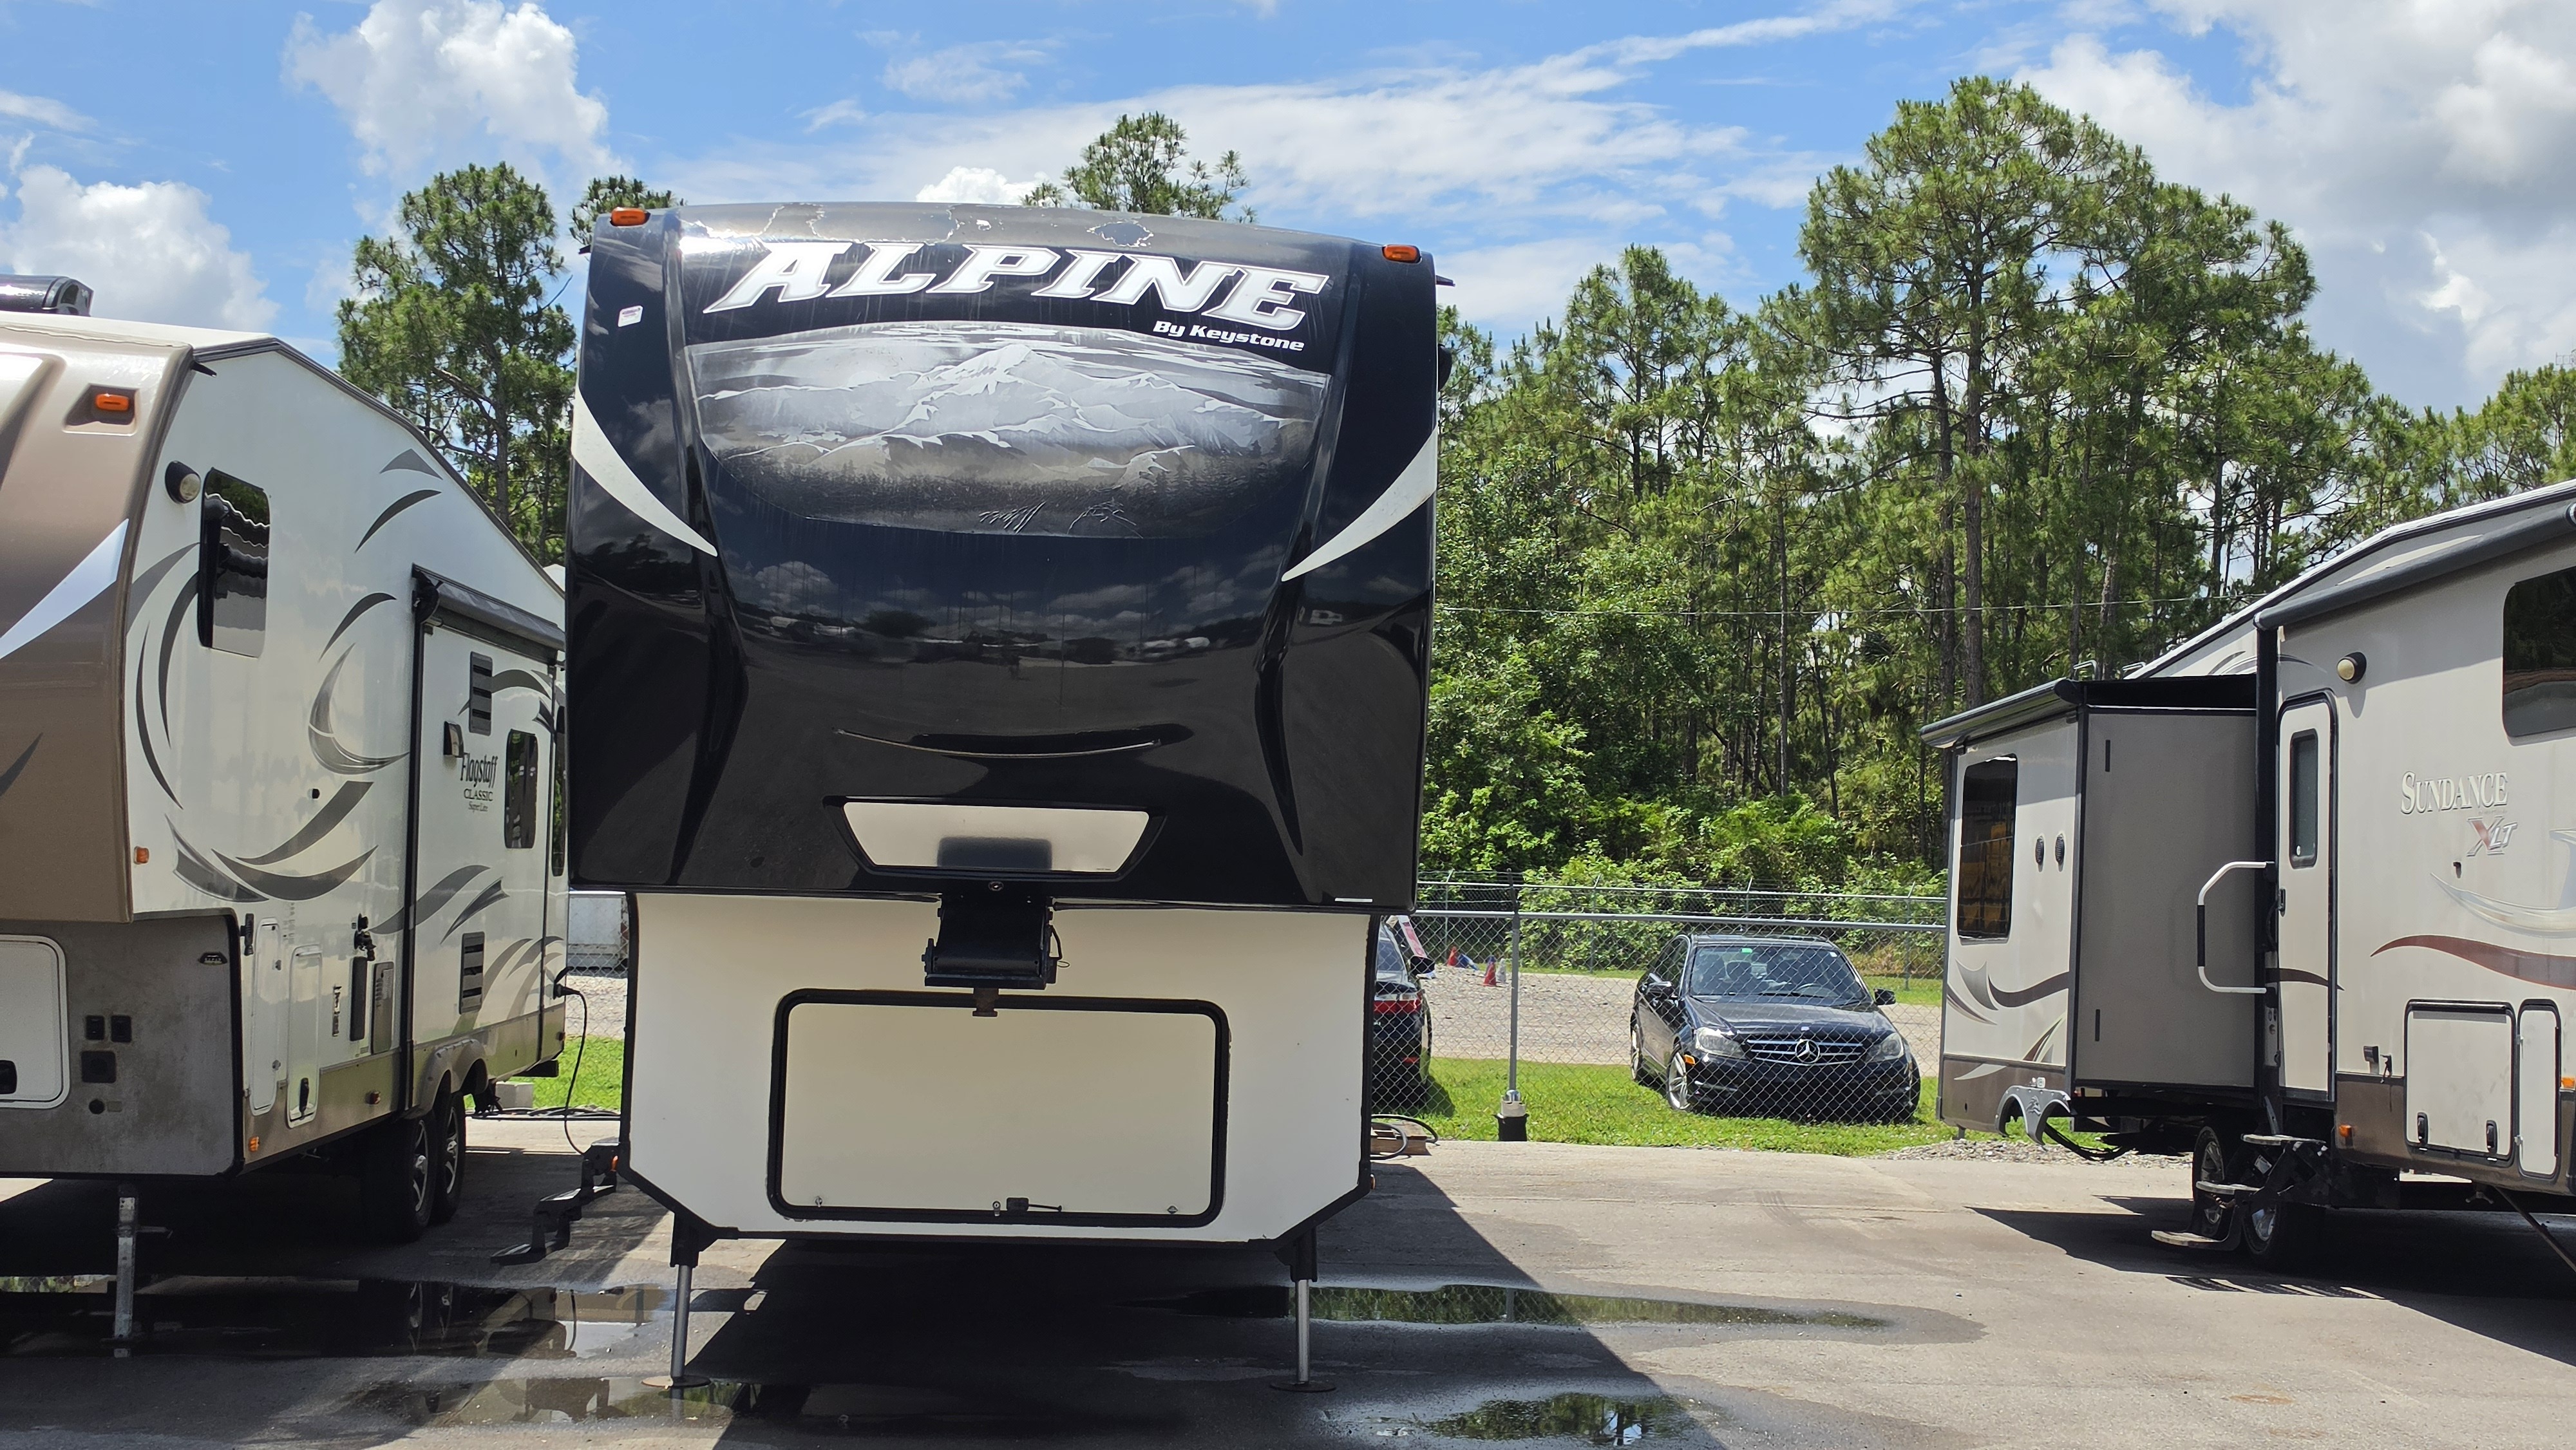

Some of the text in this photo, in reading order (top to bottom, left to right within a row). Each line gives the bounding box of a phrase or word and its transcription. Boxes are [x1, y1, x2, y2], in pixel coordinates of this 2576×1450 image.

[703, 241, 1330, 330] ALPINE
[1153, 320, 1305, 352] By Keystone
[460, 751, 498, 789] Flagstaff
[464, 787, 493, 802] CLASSIC
[2401, 771, 2508, 814] SUNDANCE
[2466, 814, 2517, 858] XLT
